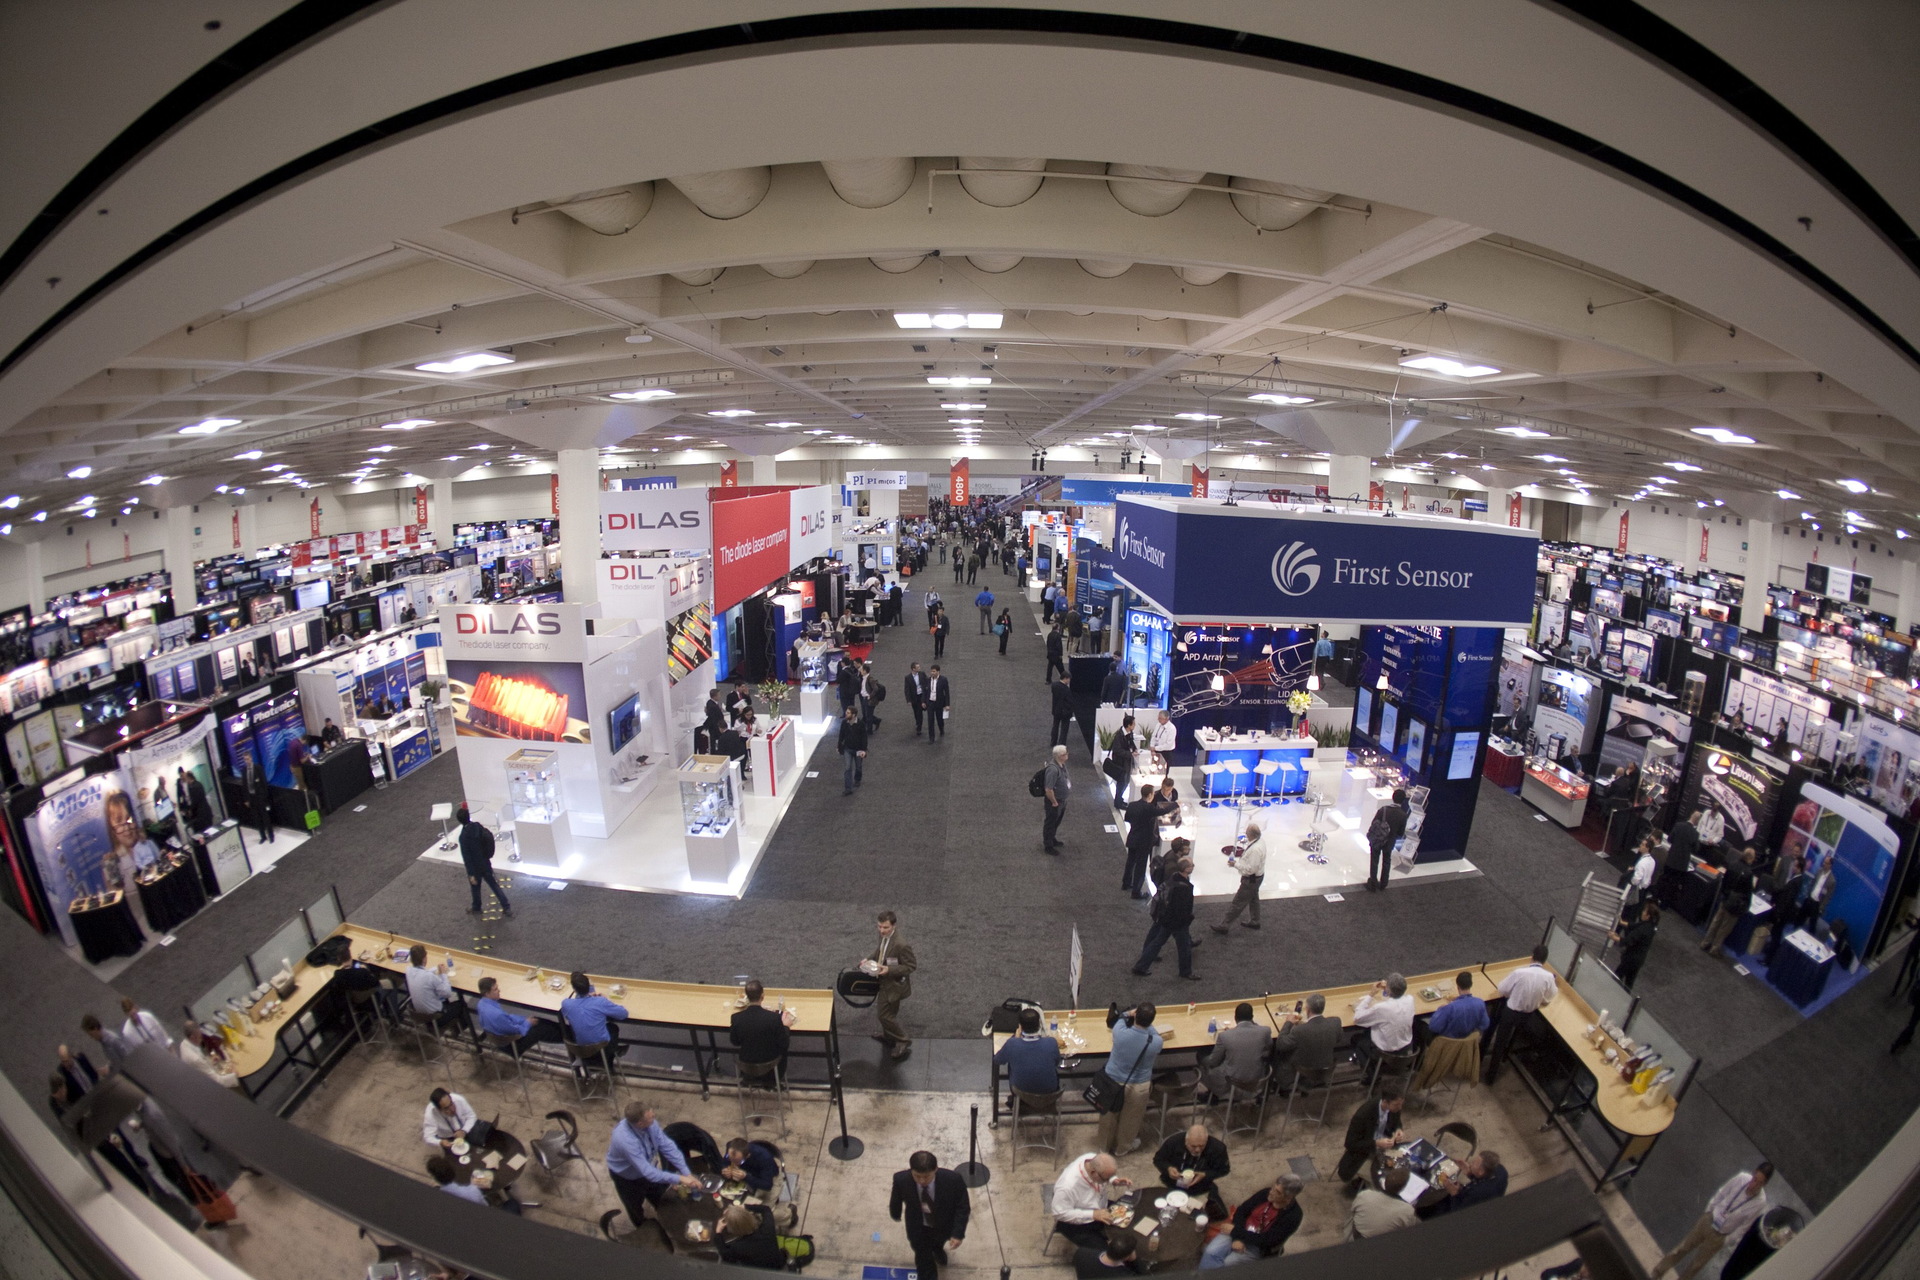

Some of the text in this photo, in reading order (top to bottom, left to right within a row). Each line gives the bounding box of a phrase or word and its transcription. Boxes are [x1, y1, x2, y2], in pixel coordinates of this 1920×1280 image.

[853, 475, 864, 486] PI
[956, 476, 964, 502] 4800
[608, 511, 700, 530] DILAS
[801, 510, 825, 537] DILAS
[832, 514, 842, 523] PI
[720, 528, 787, 565] The diode laser company
[1130, 531, 1166, 569] First Sensor
[670, 567, 705, 596] DILAS
[1333, 558, 1473, 589] First Sensor
[456, 612, 561, 635] DILAS
[1132, 613, 1162, 631] OHARA
[493, 641, 511, 649] laser
[513, 643, 551, 651] company.
[1200, 634, 1240, 643] First Sensor
[1183, 653, 1224, 661] APD Array
[253, 698, 296, 723] Photonics
[1869, 722, 1884, 734] Laird
[1731, 763, 1751, 783] Litron
